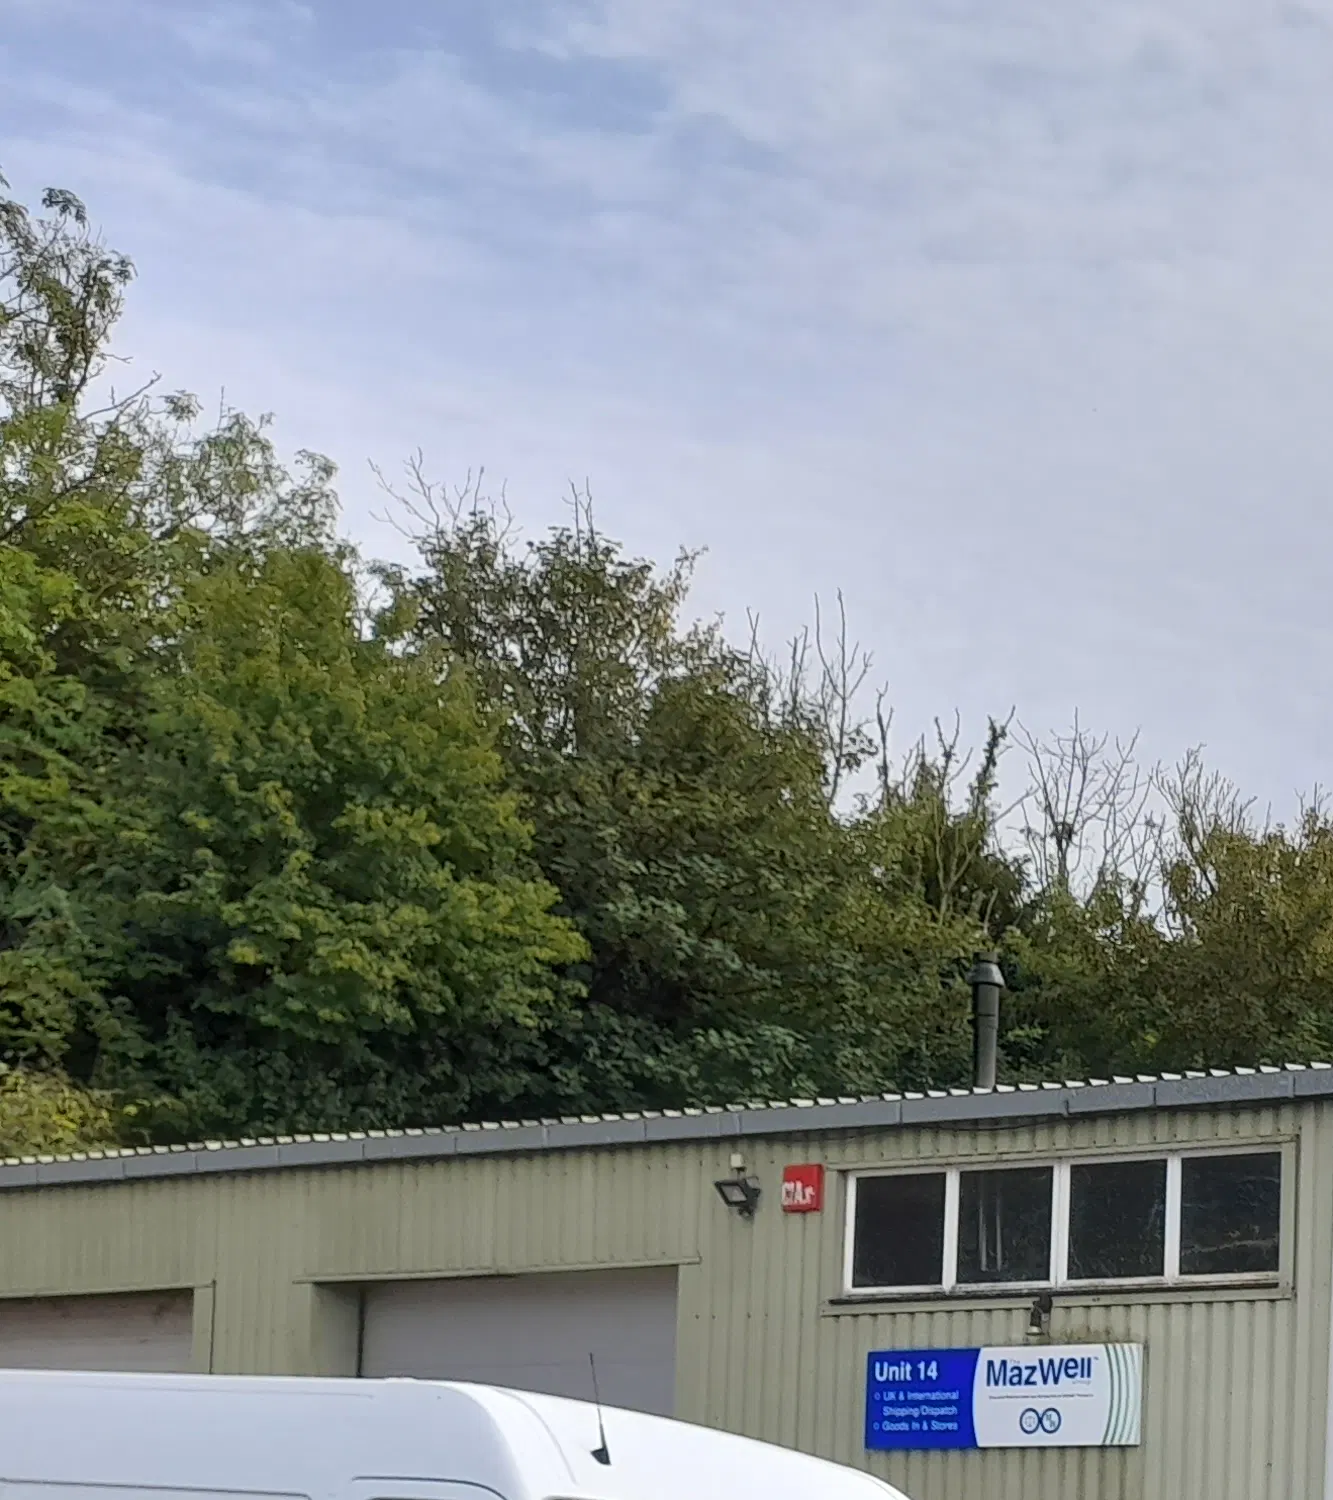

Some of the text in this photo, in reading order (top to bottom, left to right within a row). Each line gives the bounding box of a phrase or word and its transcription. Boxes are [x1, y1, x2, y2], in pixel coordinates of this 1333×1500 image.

[875, 1361, 938, 1381] Unit 14
[986, 1357, 1092, 1387] MazWell
[883, 1391, 897, 1401] UK
[907, 1390, 959, 1400] International
[882, 1420, 909, 1431] Goods
[931, 1420, 958, 1431] Stores
